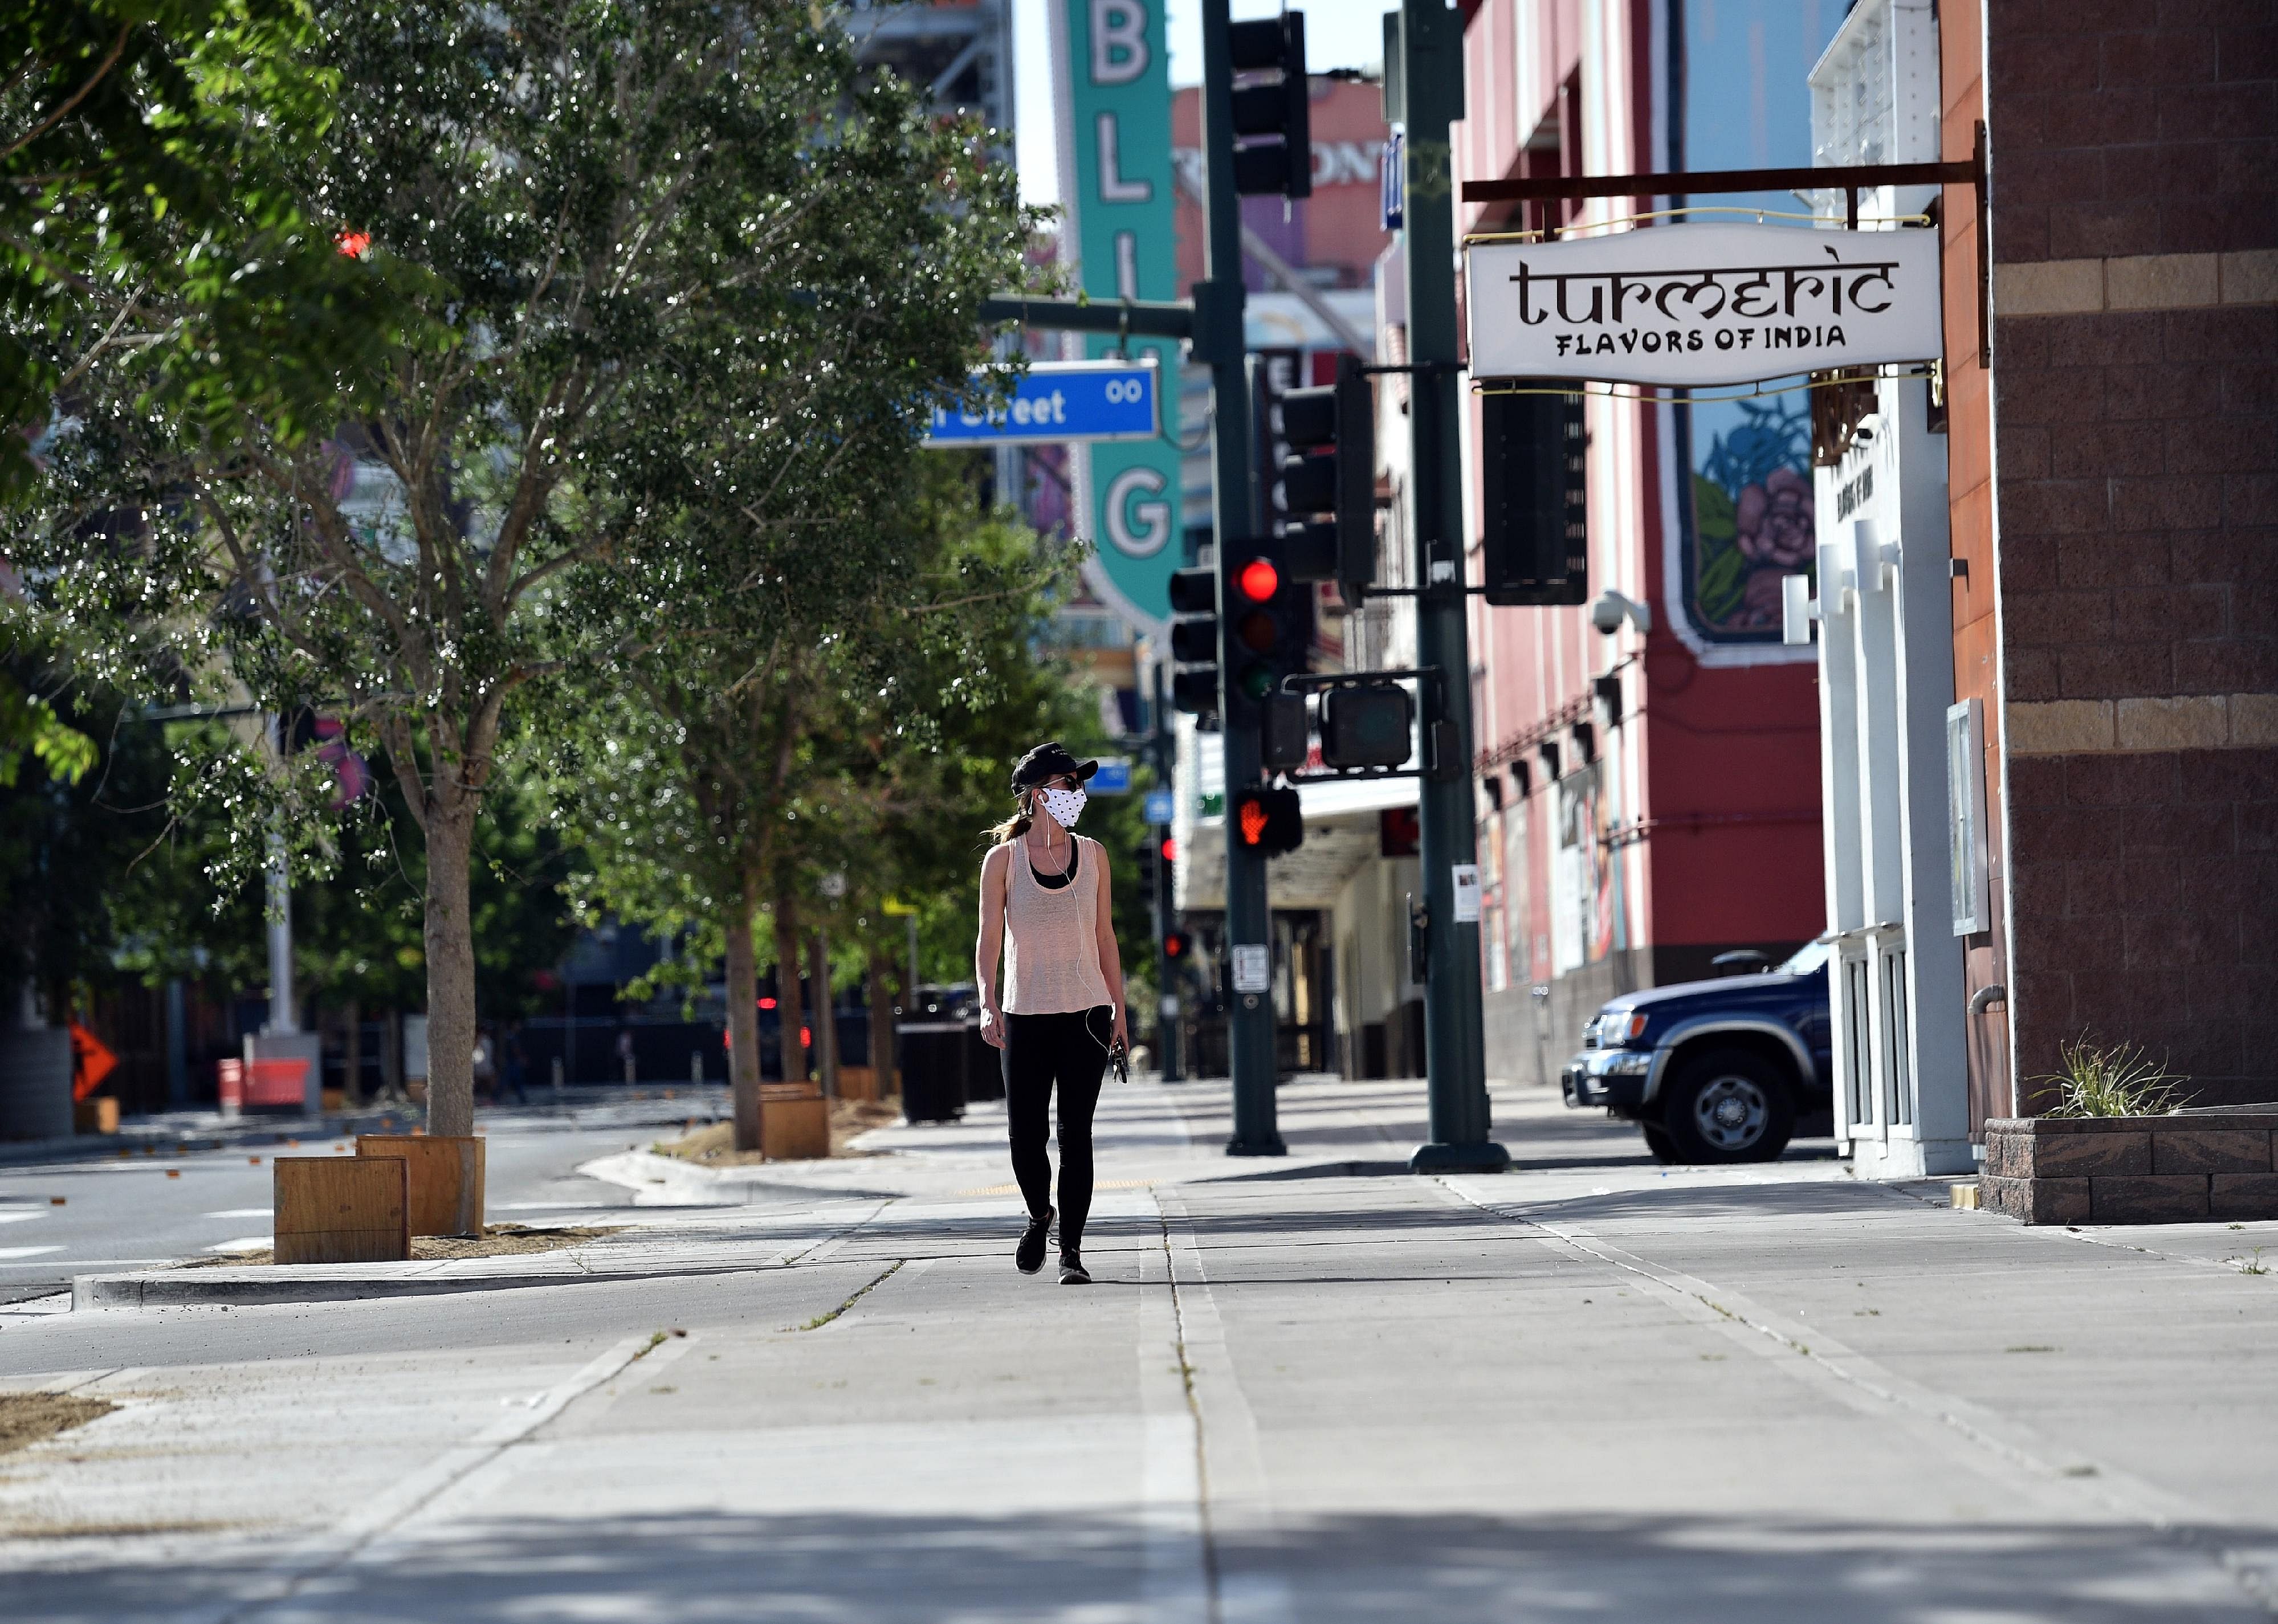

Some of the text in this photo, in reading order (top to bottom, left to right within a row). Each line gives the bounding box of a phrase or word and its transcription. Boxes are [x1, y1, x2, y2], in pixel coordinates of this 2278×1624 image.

[1091, 0, 1170, 557] BLIG
[1555, 325, 1847, 357] FLAVORS OF INDIA
